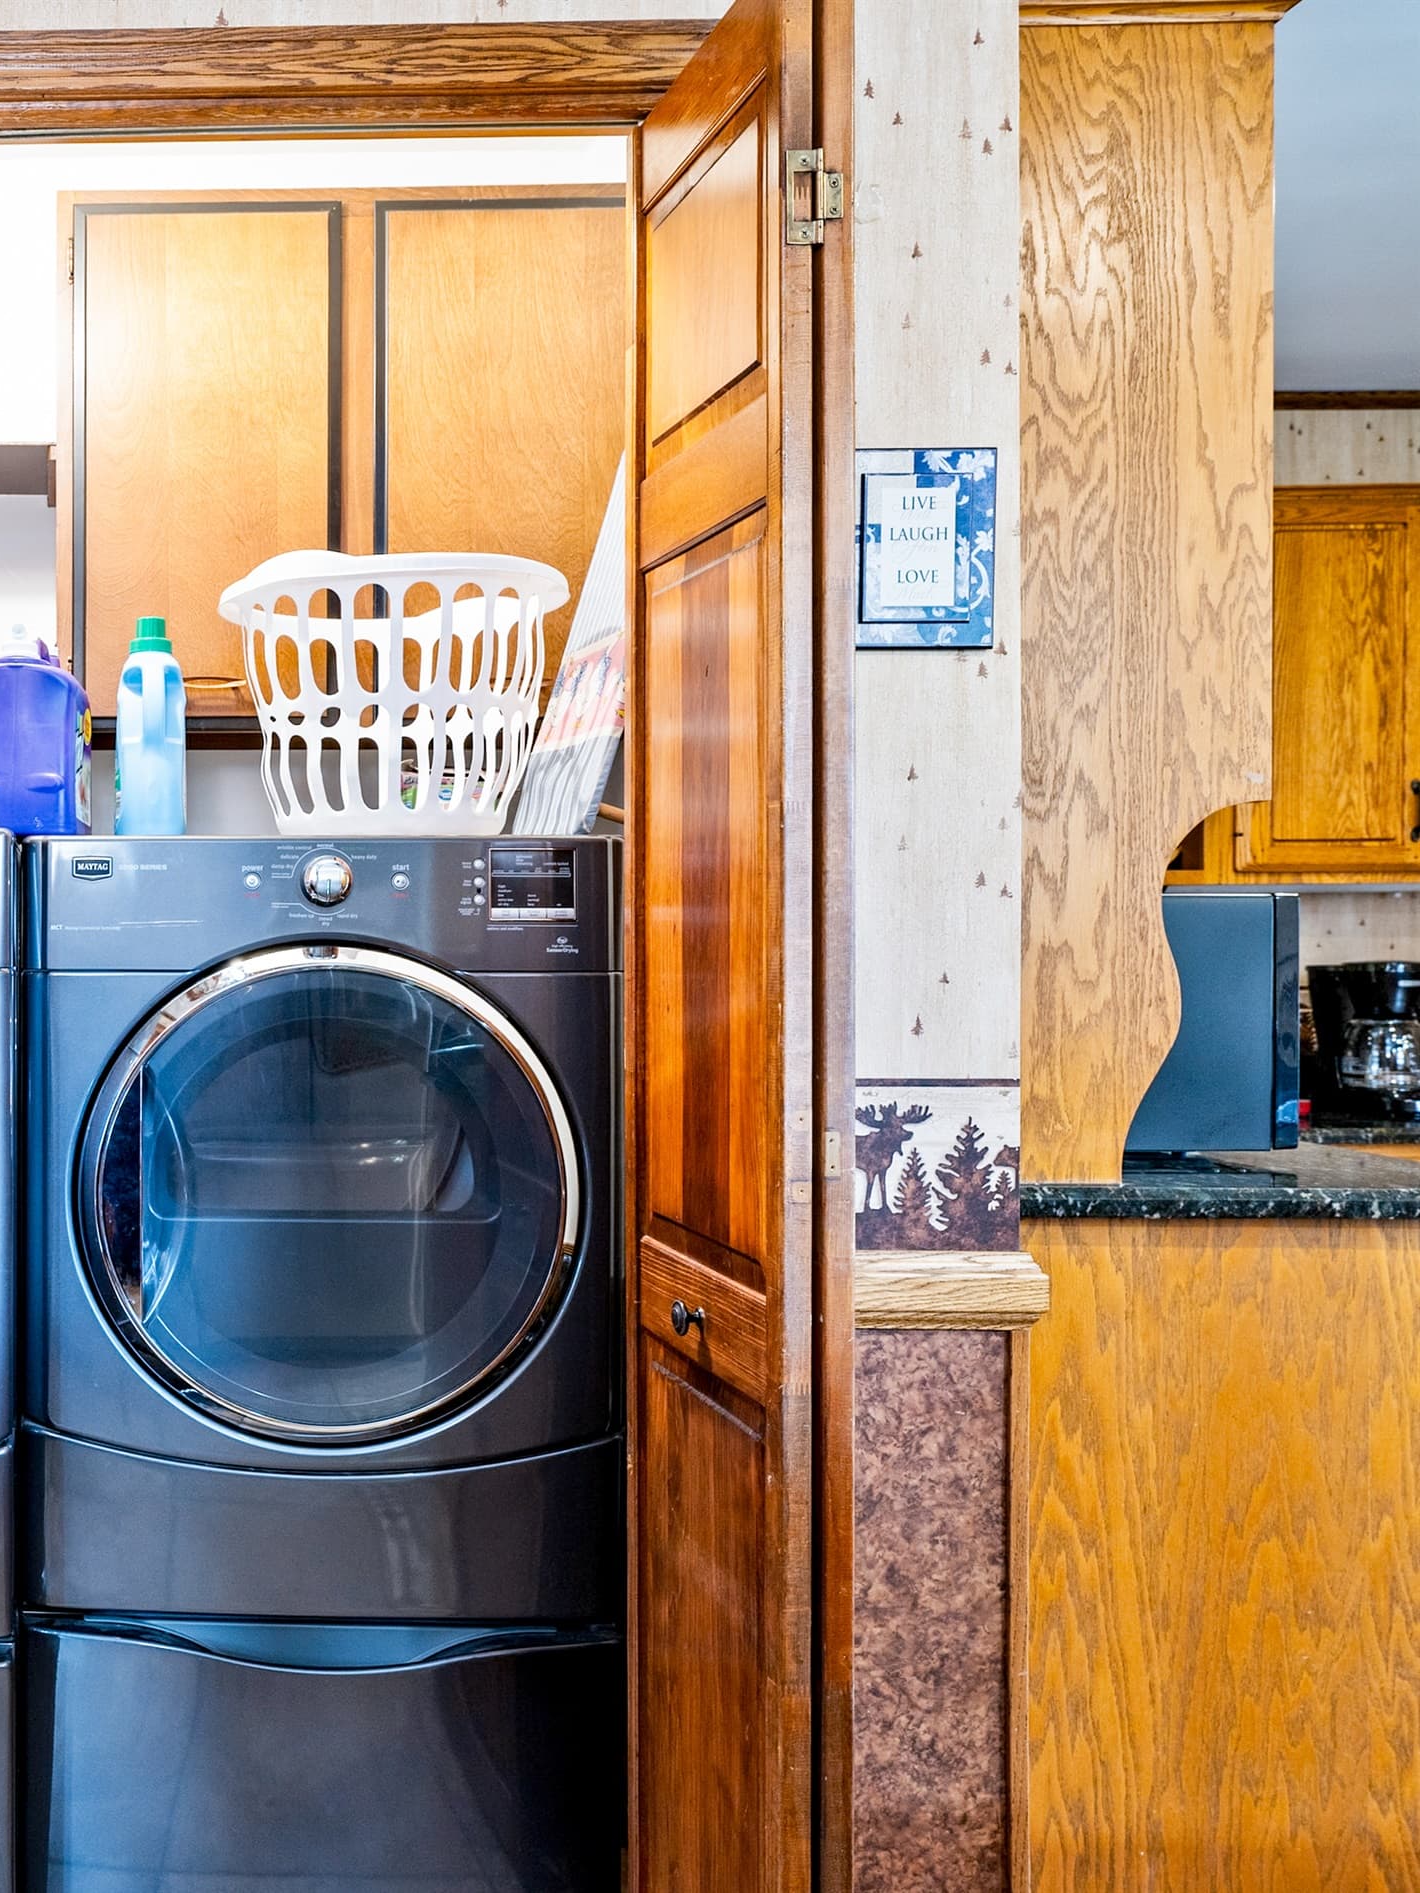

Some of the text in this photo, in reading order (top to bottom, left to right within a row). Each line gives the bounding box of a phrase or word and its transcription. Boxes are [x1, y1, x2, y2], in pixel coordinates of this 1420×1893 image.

[902, 495, 937, 510] LIVE
[889, 526, 949, 542] LAUGH
[897, 569, 939, 584] LOVE
[241, 865, 264, 873] power
[392, 863, 410, 871] start
